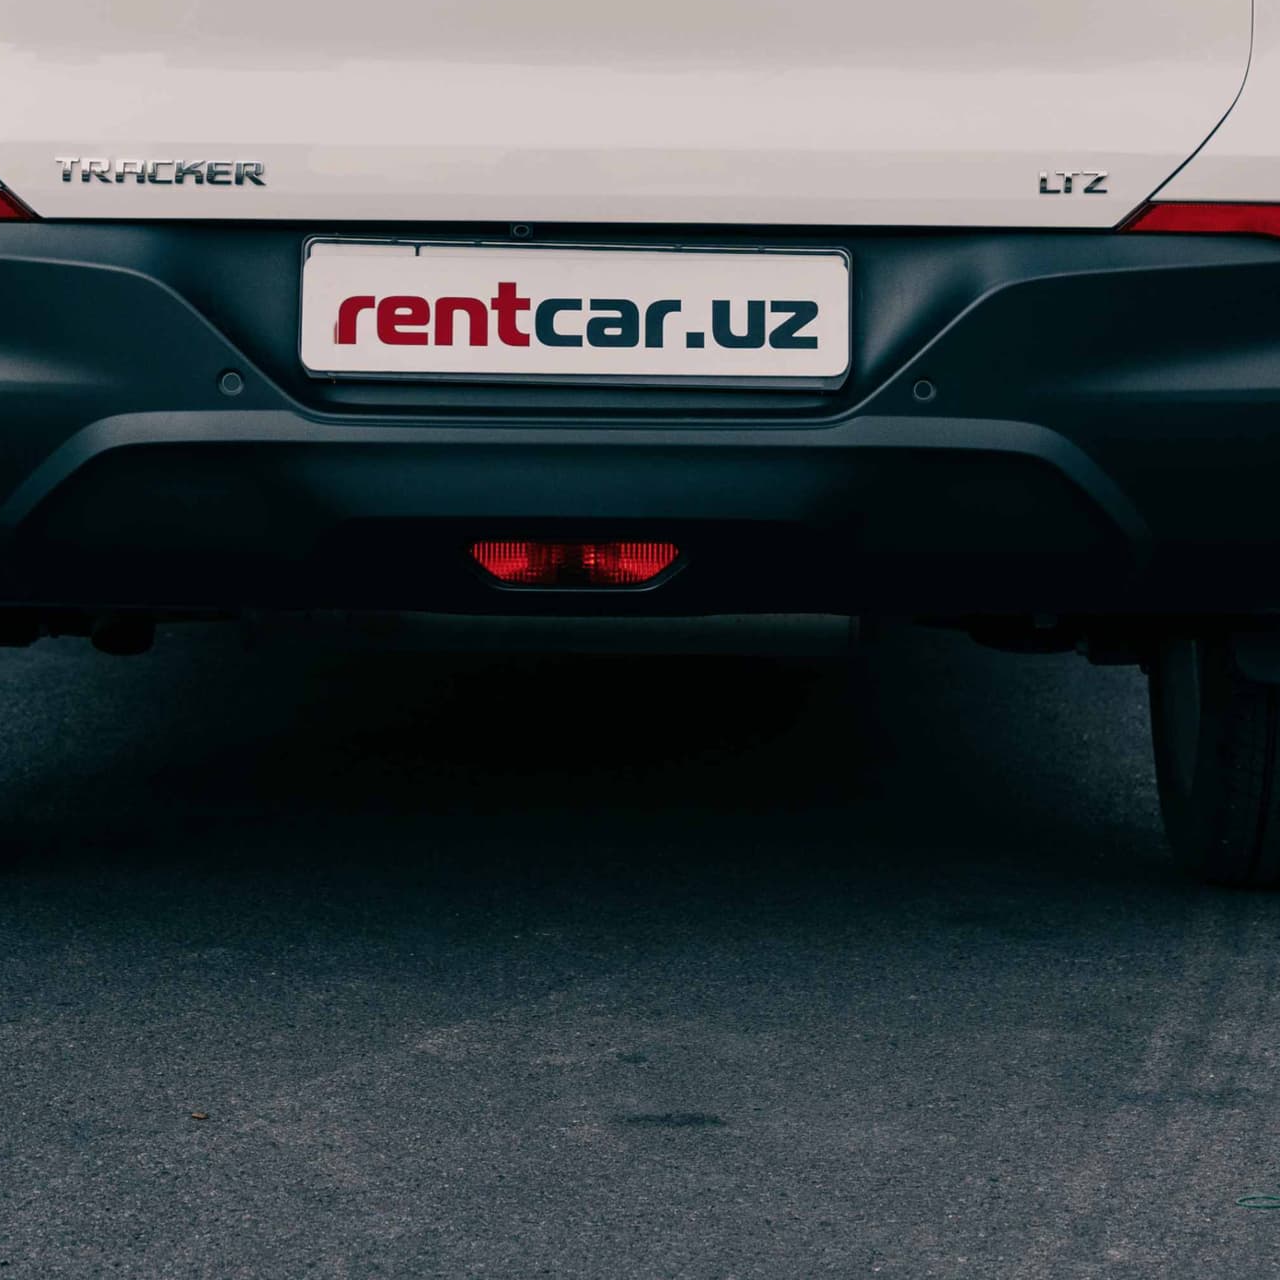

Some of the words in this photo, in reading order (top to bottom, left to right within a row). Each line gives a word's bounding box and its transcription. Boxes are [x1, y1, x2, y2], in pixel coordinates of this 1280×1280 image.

[55, 157, 266, 186] TRACKER
[1039, 170, 1108, 194] LTZ
[337, 281, 819, 350] rentcar.uz
